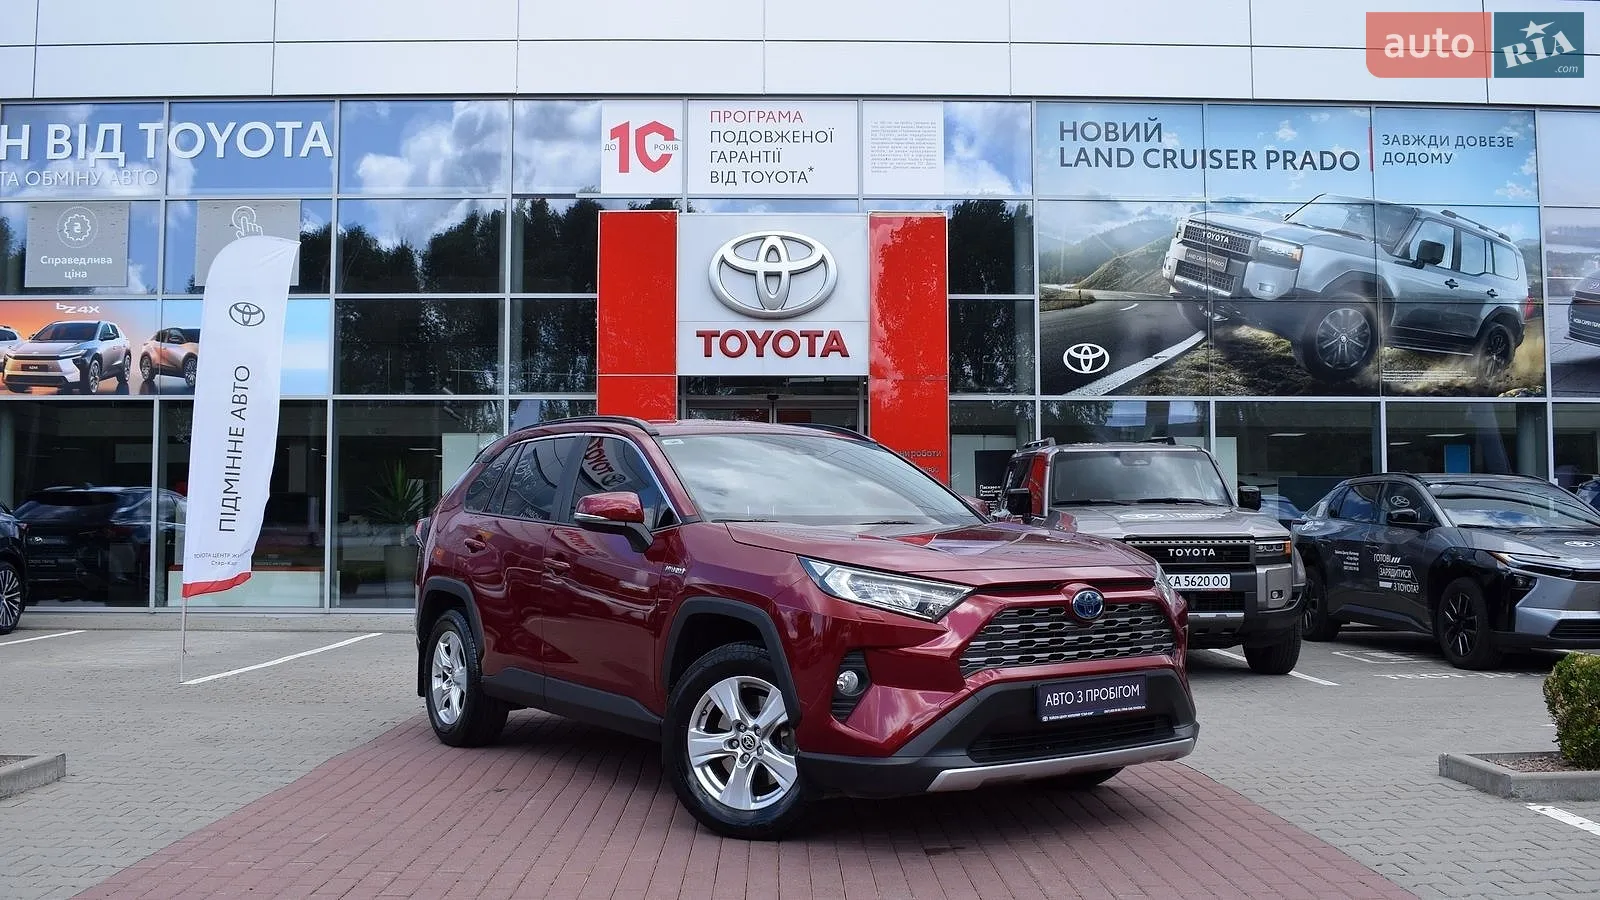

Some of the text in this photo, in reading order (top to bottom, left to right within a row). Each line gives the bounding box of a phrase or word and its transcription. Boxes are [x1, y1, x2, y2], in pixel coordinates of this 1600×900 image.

[710, 110, 804, 124] ПРОГРАМА
[710, 127, 835, 146] ПОДОВЖЕНОЇ
[1059, 116, 1163, 143] НОВИЙ
[46, 123, 126, 168] ВІД
[138, 120, 335, 160] TOYOTA
[604, 143, 617, 151] ДО
[654, 143, 679, 152] РОКІВ
[1382, 134, 1514, 149] ЗАВЖДИ ДОВЕЗЕ
[710, 147, 783, 164] ГАРАНТІЇ
[1059, 147, 1361, 172] LAND CRUISER PRADO
[1382, 152, 1453, 166] ДОДОМУ
[25, 170, 101, 187] ОБМІНУ
[110, 169, 159, 186] АВТО
[710, 170, 738, 187] ВІД
[1202, 231, 1229, 243] TOYOTA
[40, 255, 113, 266] Справедлива
[64, 269, 88, 280] ціна
[696, 329, 850, 357] TOYOTA
[230, 365, 251, 421] АВТО
[219, 426, 245, 532] ПІДМІННЕ
[1168, 548, 1216, 557] TOYOTA
[1184, 576, 1210, 587] 5620
[1045, 684, 1140, 706] АВТО З ПРОБІГОМ
